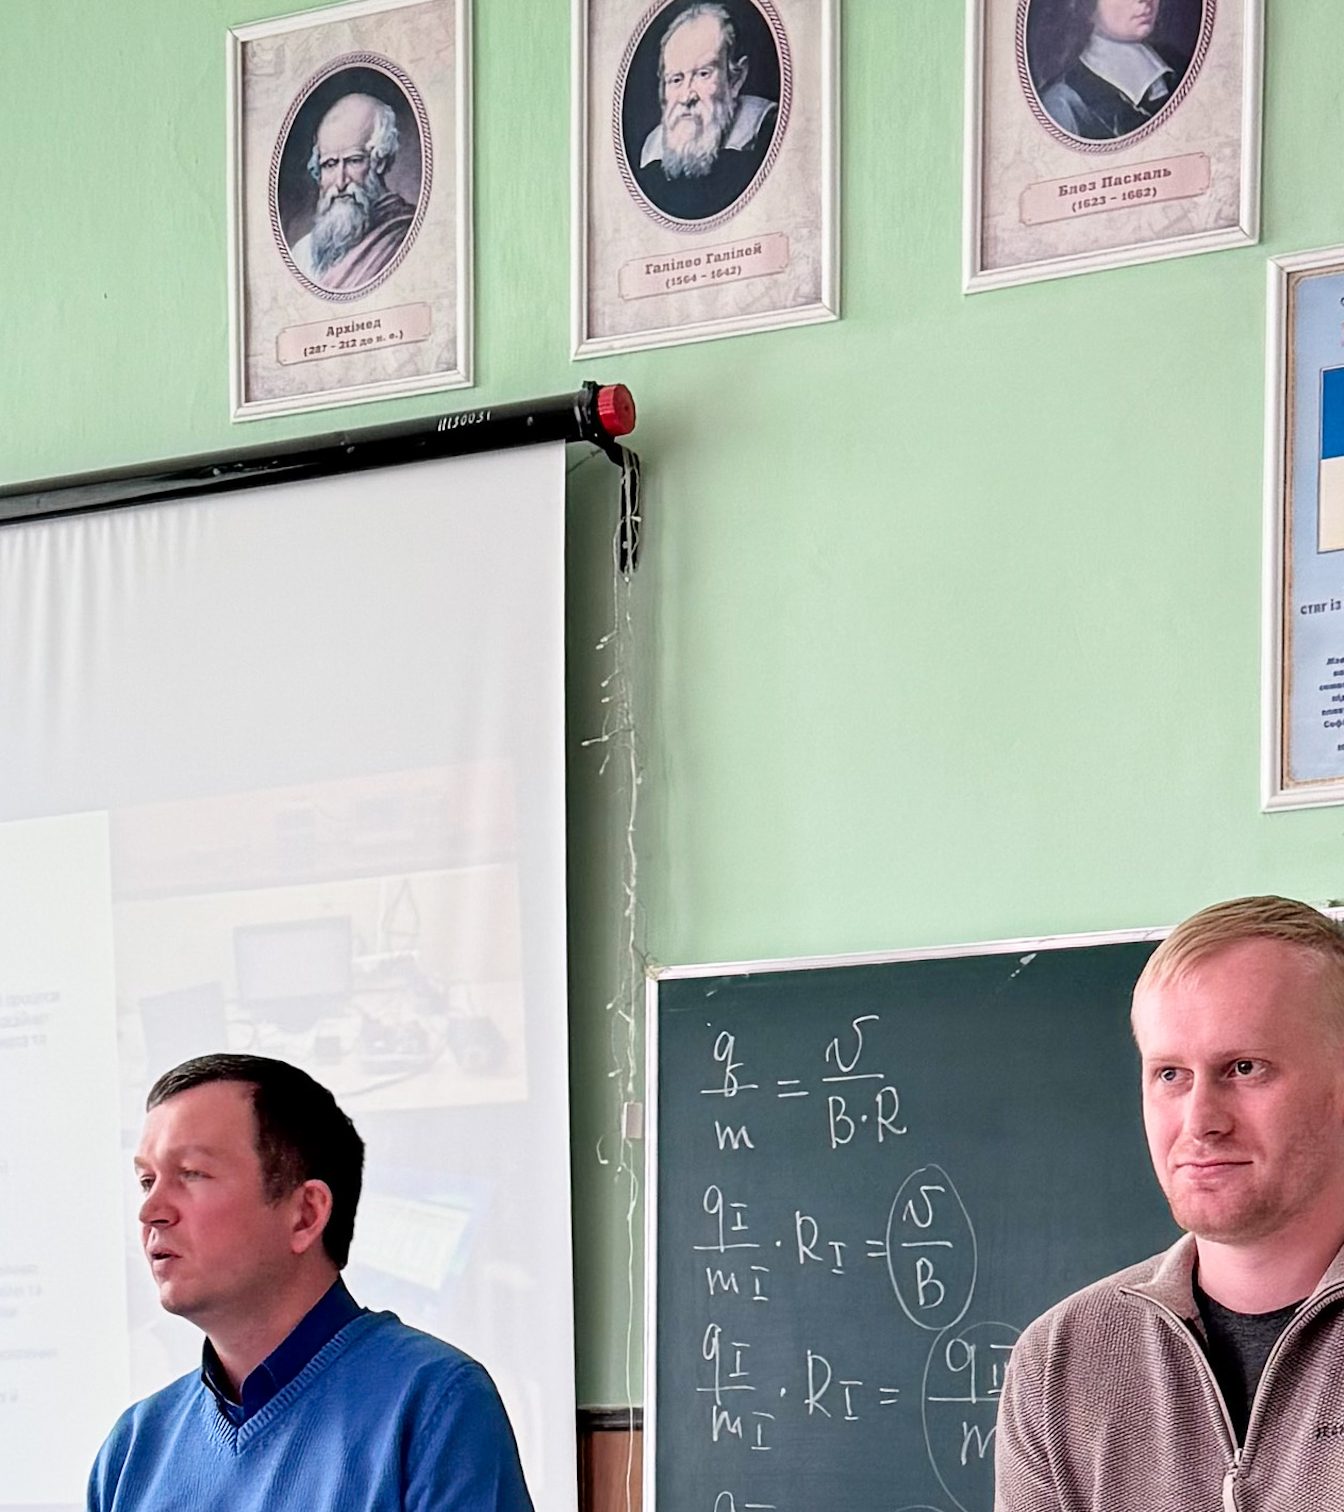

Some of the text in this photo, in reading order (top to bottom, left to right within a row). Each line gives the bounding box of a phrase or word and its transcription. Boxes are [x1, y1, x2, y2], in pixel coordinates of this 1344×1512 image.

[1058, 167, 1172, 197] Блез Паскаль
[1071, 186, 1157, 212] (1623 1662)
[645, 242, 762, 275] Галілео Галілей
[665, 272, 697, 288] (1564
[326, 318, 382, 338] Архімед
[1300, 603, 1327, 615] стяг
[1330, 598, 1341, 611] із
